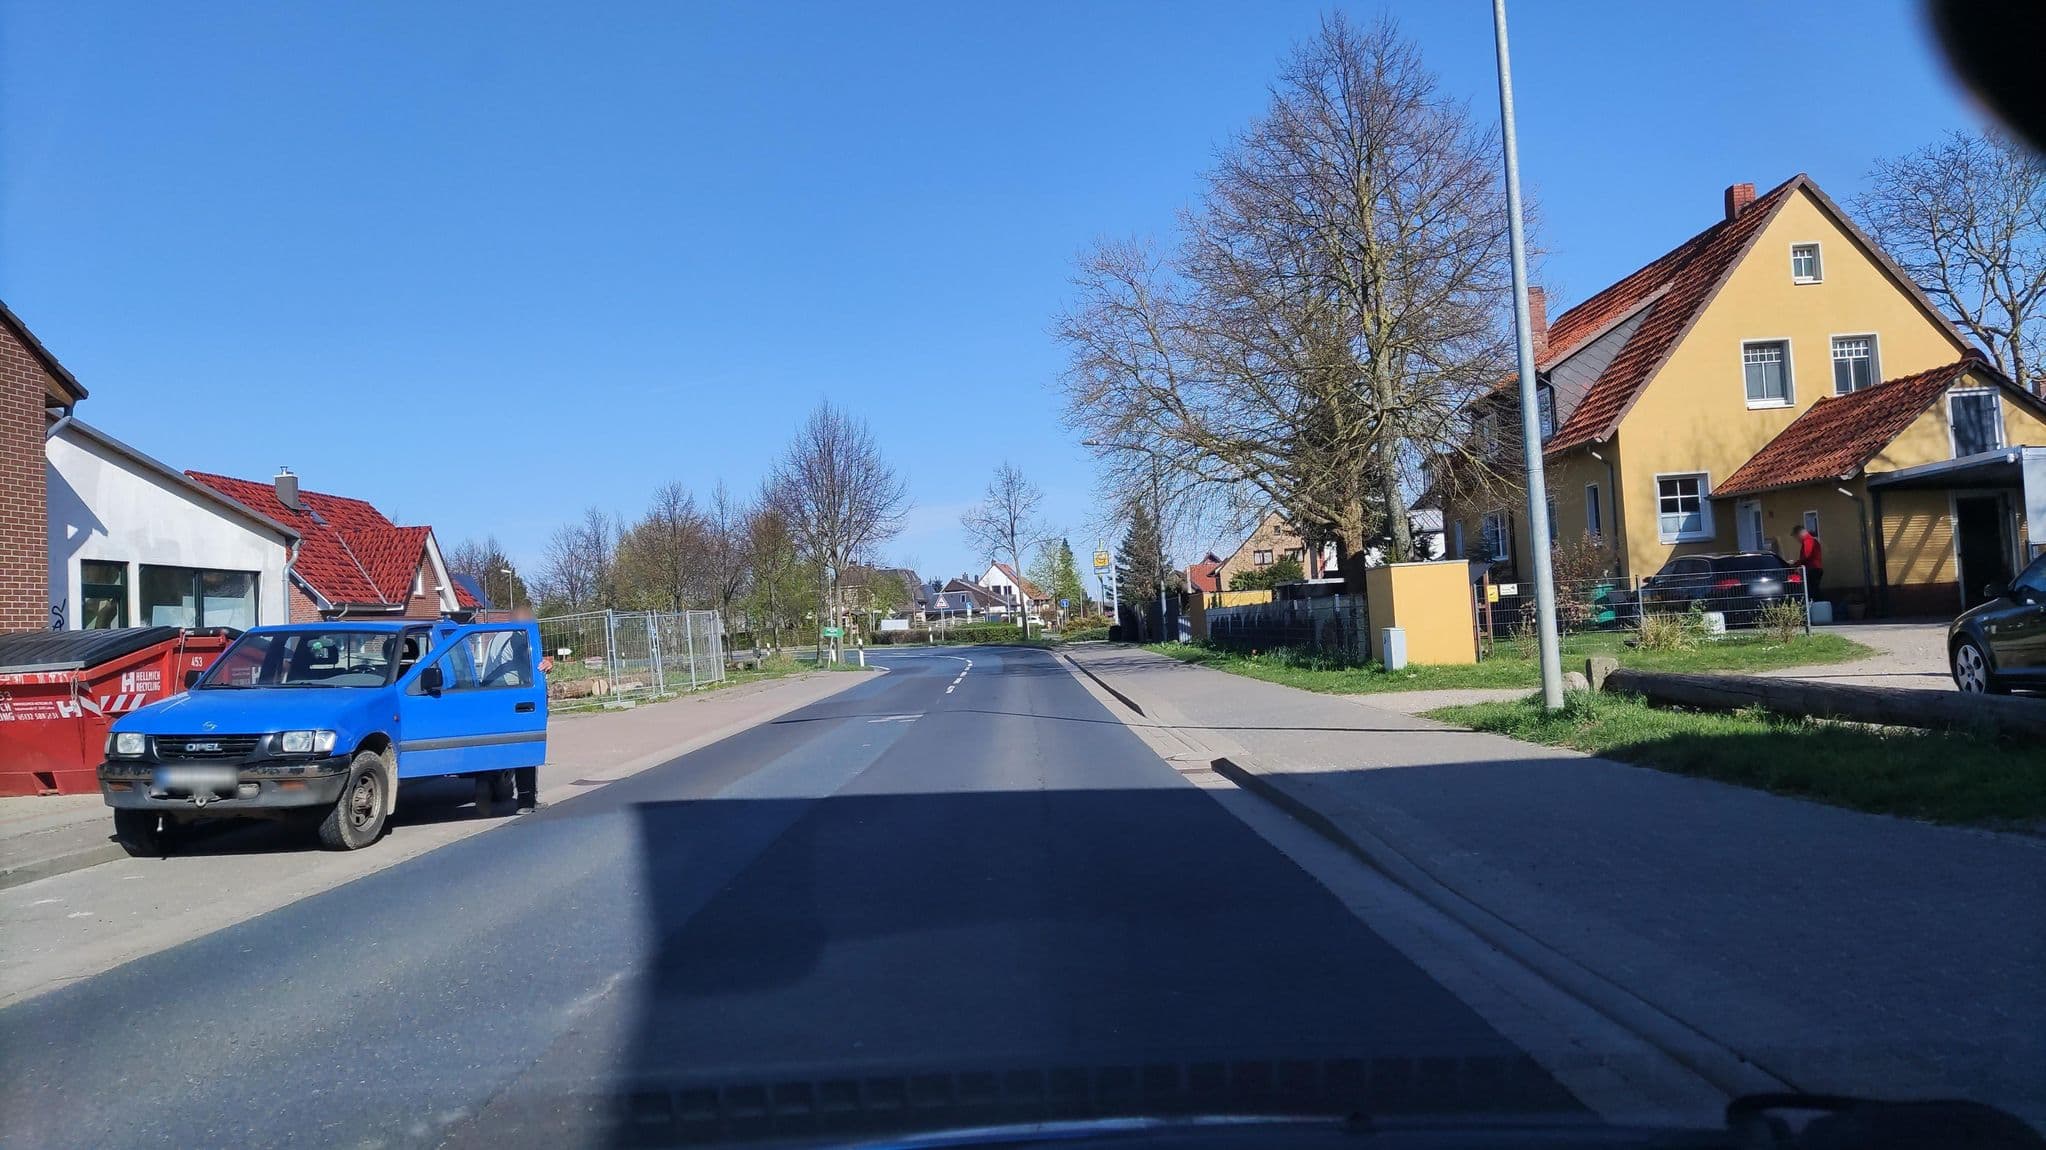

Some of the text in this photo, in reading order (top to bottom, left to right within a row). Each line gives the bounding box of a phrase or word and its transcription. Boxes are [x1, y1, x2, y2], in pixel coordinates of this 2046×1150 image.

[190, 656, 203, 667] 453
[136, 671, 160, 681] HELLMICH
[136, 681, 160, 692] RECYCLING
[186, 743, 223, 751] OPEL
